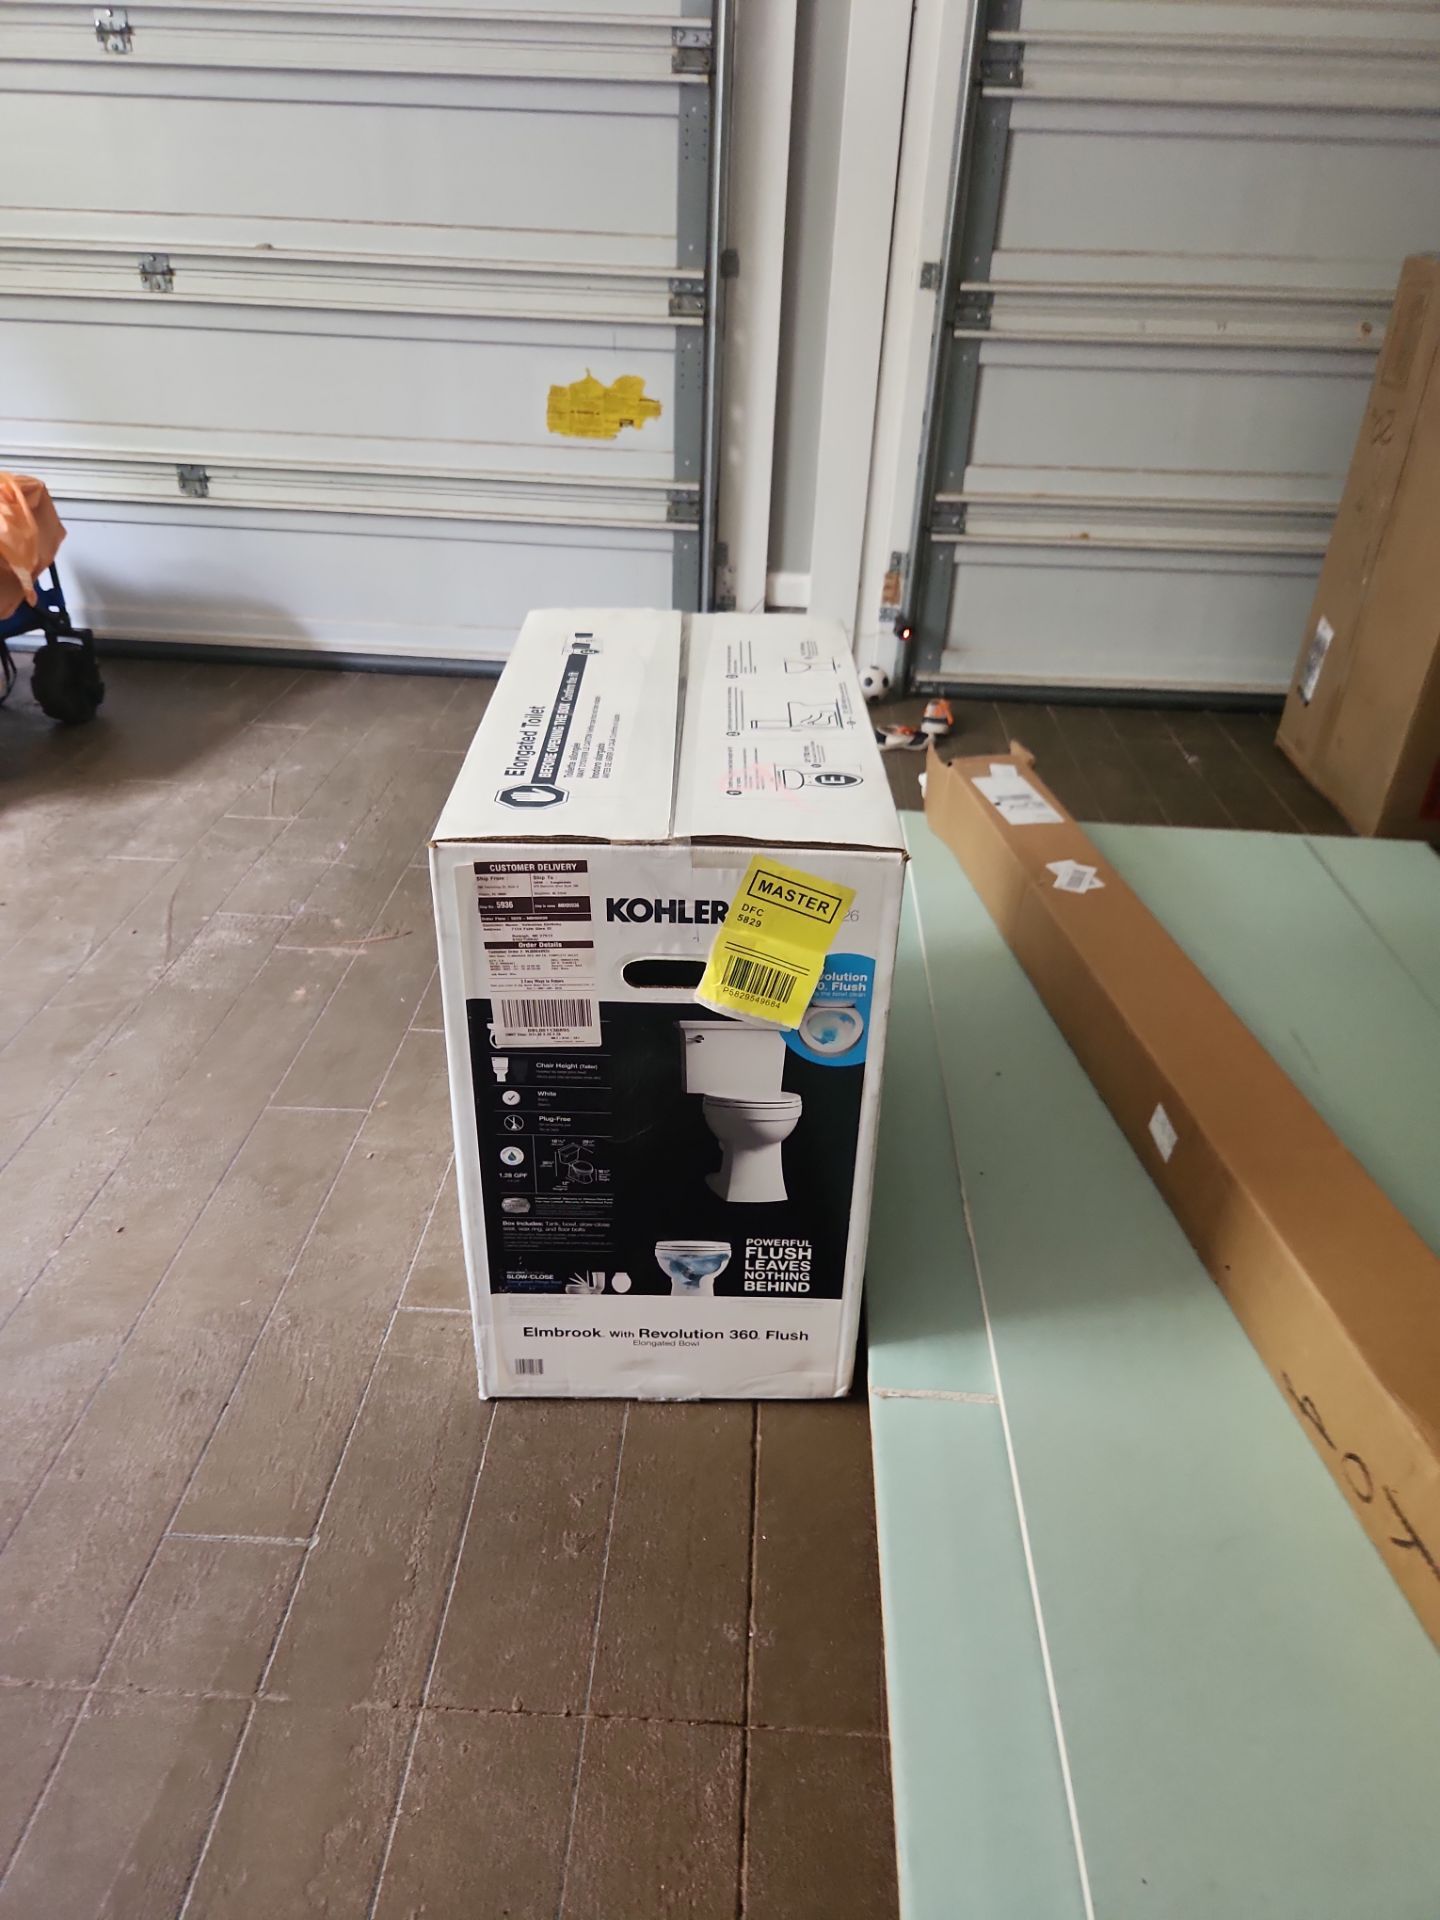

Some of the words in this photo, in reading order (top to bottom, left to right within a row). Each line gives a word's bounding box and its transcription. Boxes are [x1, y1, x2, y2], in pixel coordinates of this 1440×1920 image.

[521, 705, 546, 728] Toilet
[554, 714, 568, 726] THE
[546, 726, 565, 753] OPENING
[504, 730, 539, 777] Elongated
[538, 752, 557, 778] BEFORE
[489, 863, 535, 872] CUSTOMER
[537, 862, 577, 871] DELIVERY
[758, 879, 830, 915] MASTER
[606, 897, 729, 925] KOHLER
[741, 903, 765, 917] DFC
[736, 913, 762, 928] 5829
[831, 982, 867, 992] Flush
[555, 1062, 578, 1070] Height
[746, 1238, 813, 1247] POWERFUL
[745, 1247, 812, 1260] FLUSH
[744, 1259, 811, 1272] LEAVES
[744, 1271, 810, 1281] NOTHING
[743, 1280, 811, 1293] BEHIND
[523, 1326, 601, 1338] Elmbrook
[609, 1330, 635, 1339] With
[638, 1328, 724, 1340] Revolution
[765, 1330, 809, 1341] Flush
